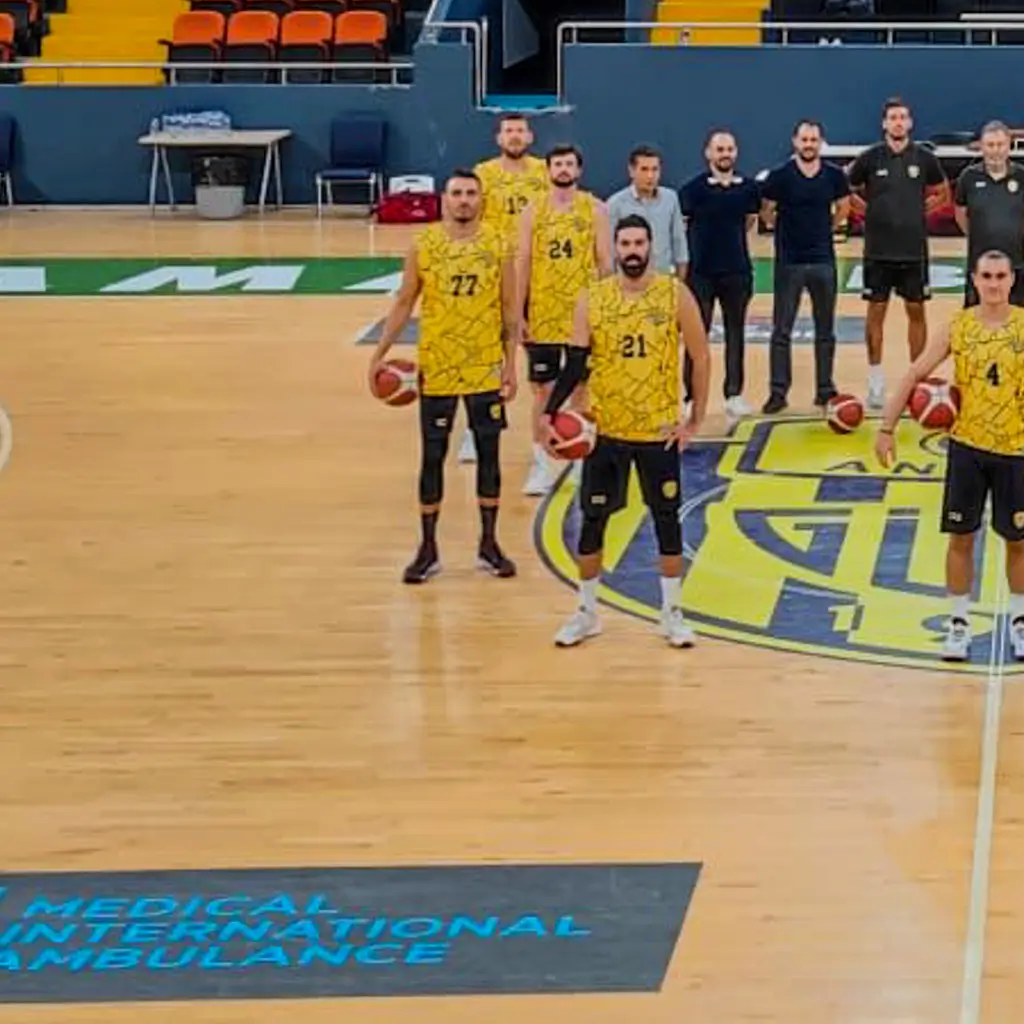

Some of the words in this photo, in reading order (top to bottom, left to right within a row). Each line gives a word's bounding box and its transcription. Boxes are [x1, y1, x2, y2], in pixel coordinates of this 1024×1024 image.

[550, 240, 573, 259] 24
[450, 275, 478, 296] 77
[621, 335, 646, 358] 21
[986, 362, 1000, 387] 4
[23, 893, 338, 919] MEDICAL
[0, 915, 591, 945] INTERNATIONAL
